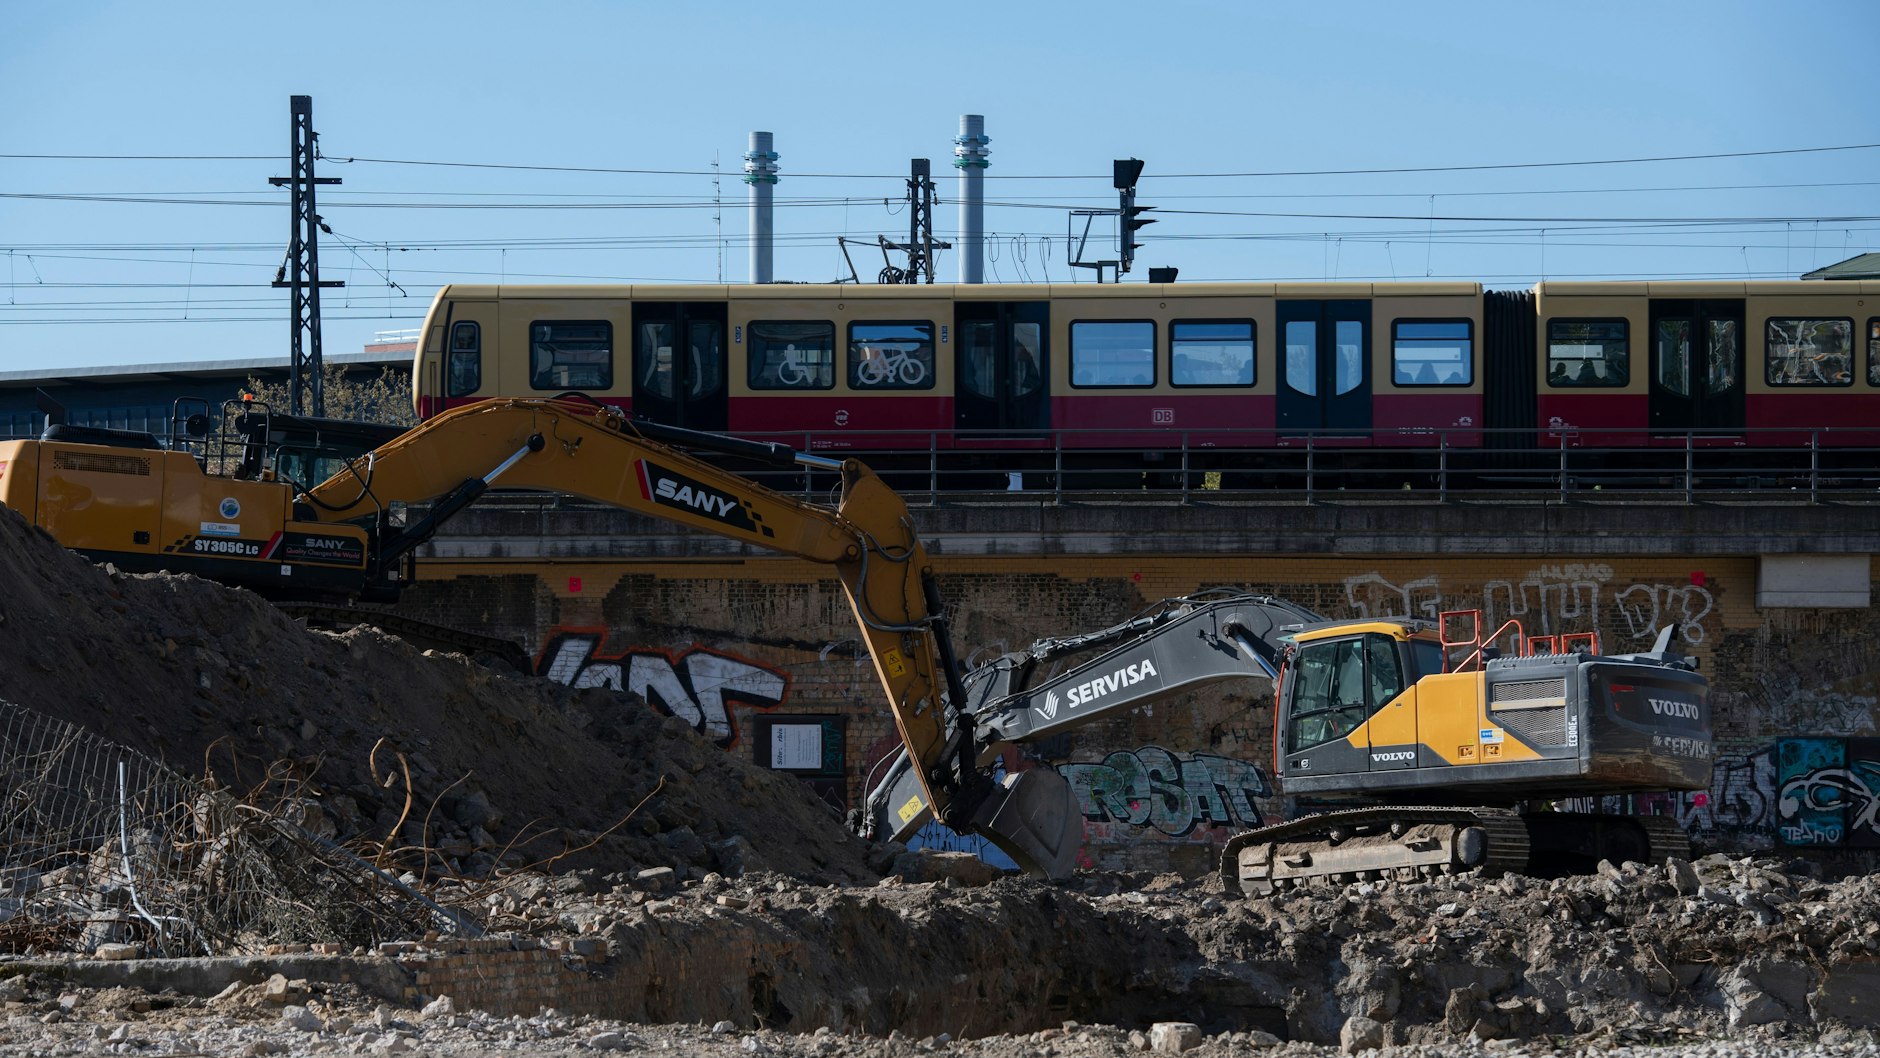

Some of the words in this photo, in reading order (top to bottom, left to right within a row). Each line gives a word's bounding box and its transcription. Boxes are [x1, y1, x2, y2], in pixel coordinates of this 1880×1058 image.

[1154, 410, 1173, 423] DB
[655, 478, 737, 517] SANY
[194, 539, 245, 555] SY305C
[245, 545, 259, 555] LC
[305, 538, 345, 550] SANY
[286, 547, 307, 556] Quality
[307, 549, 332, 558] Changes
[1066, 659, 1158, 709] SERVISA
[1648, 698, 1699, 720] VOLVO
[1371, 751, 1415, 762] VOLVO
